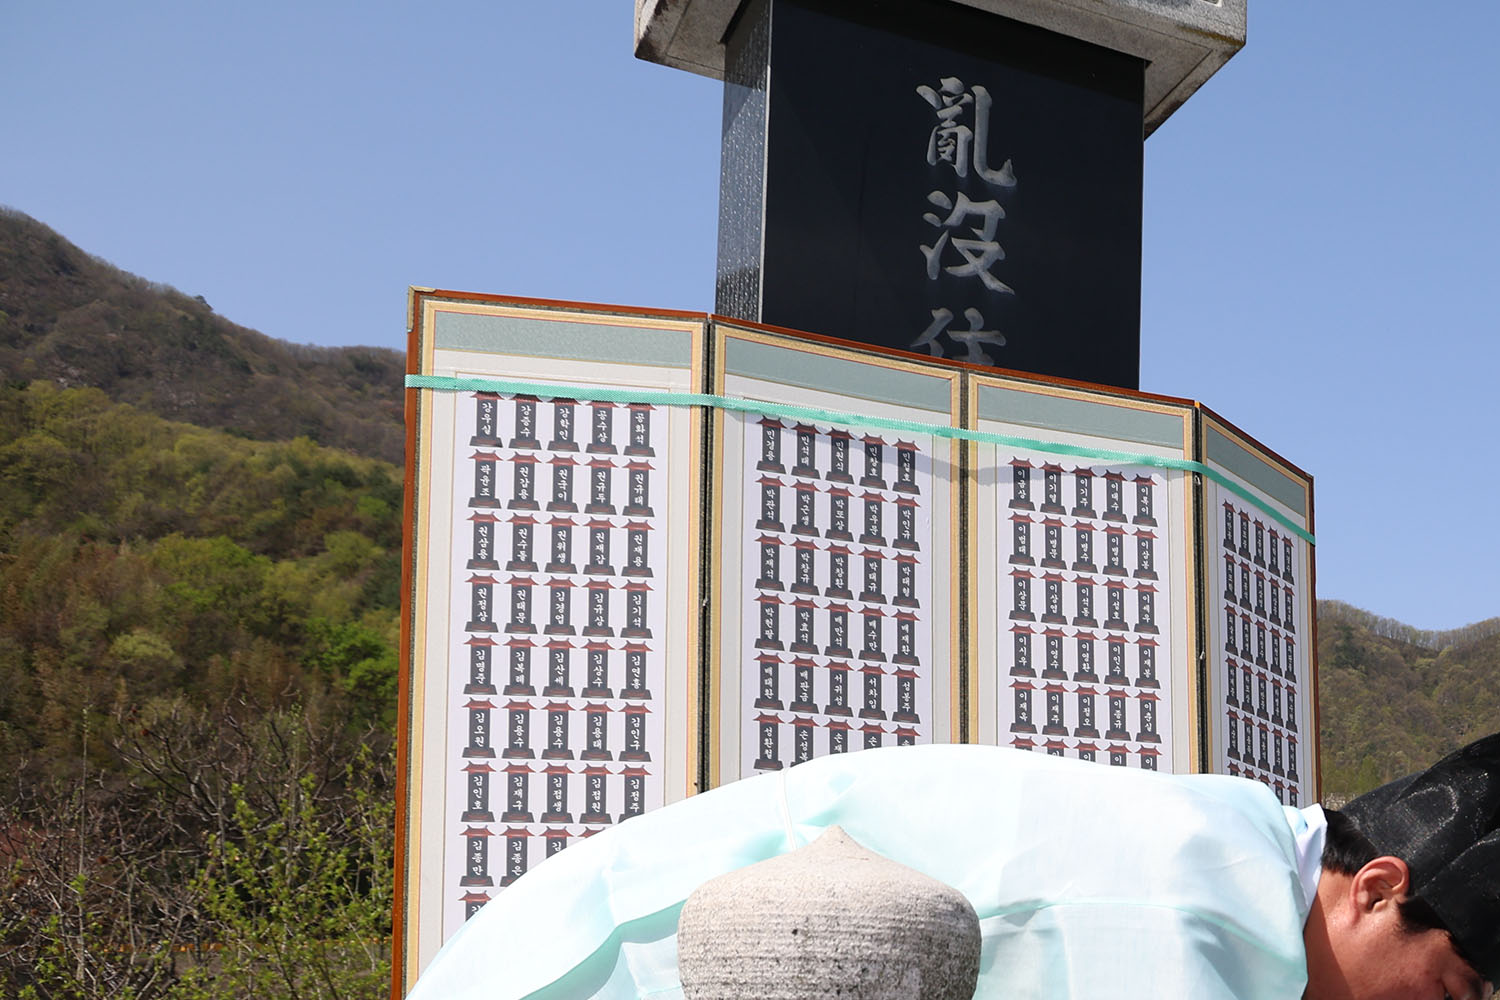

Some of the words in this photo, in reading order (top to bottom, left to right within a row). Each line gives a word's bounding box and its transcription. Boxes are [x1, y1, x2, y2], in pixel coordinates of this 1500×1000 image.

[596, 410, 608, 443] 공수상
[593, 592, 605, 627] 김규상
[632, 594, 642, 628] 김기석
[592, 653, 604, 688] 김상수
[474, 712, 485, 748] 김오원
[513, 713, 525, 748] 김용수
[552, 714, 564, 749] 김용수
[629, 716, 641, 751] 김인구
[834, 732, 843, 752] 손재
[472, 775, 483, 810] 김인호
